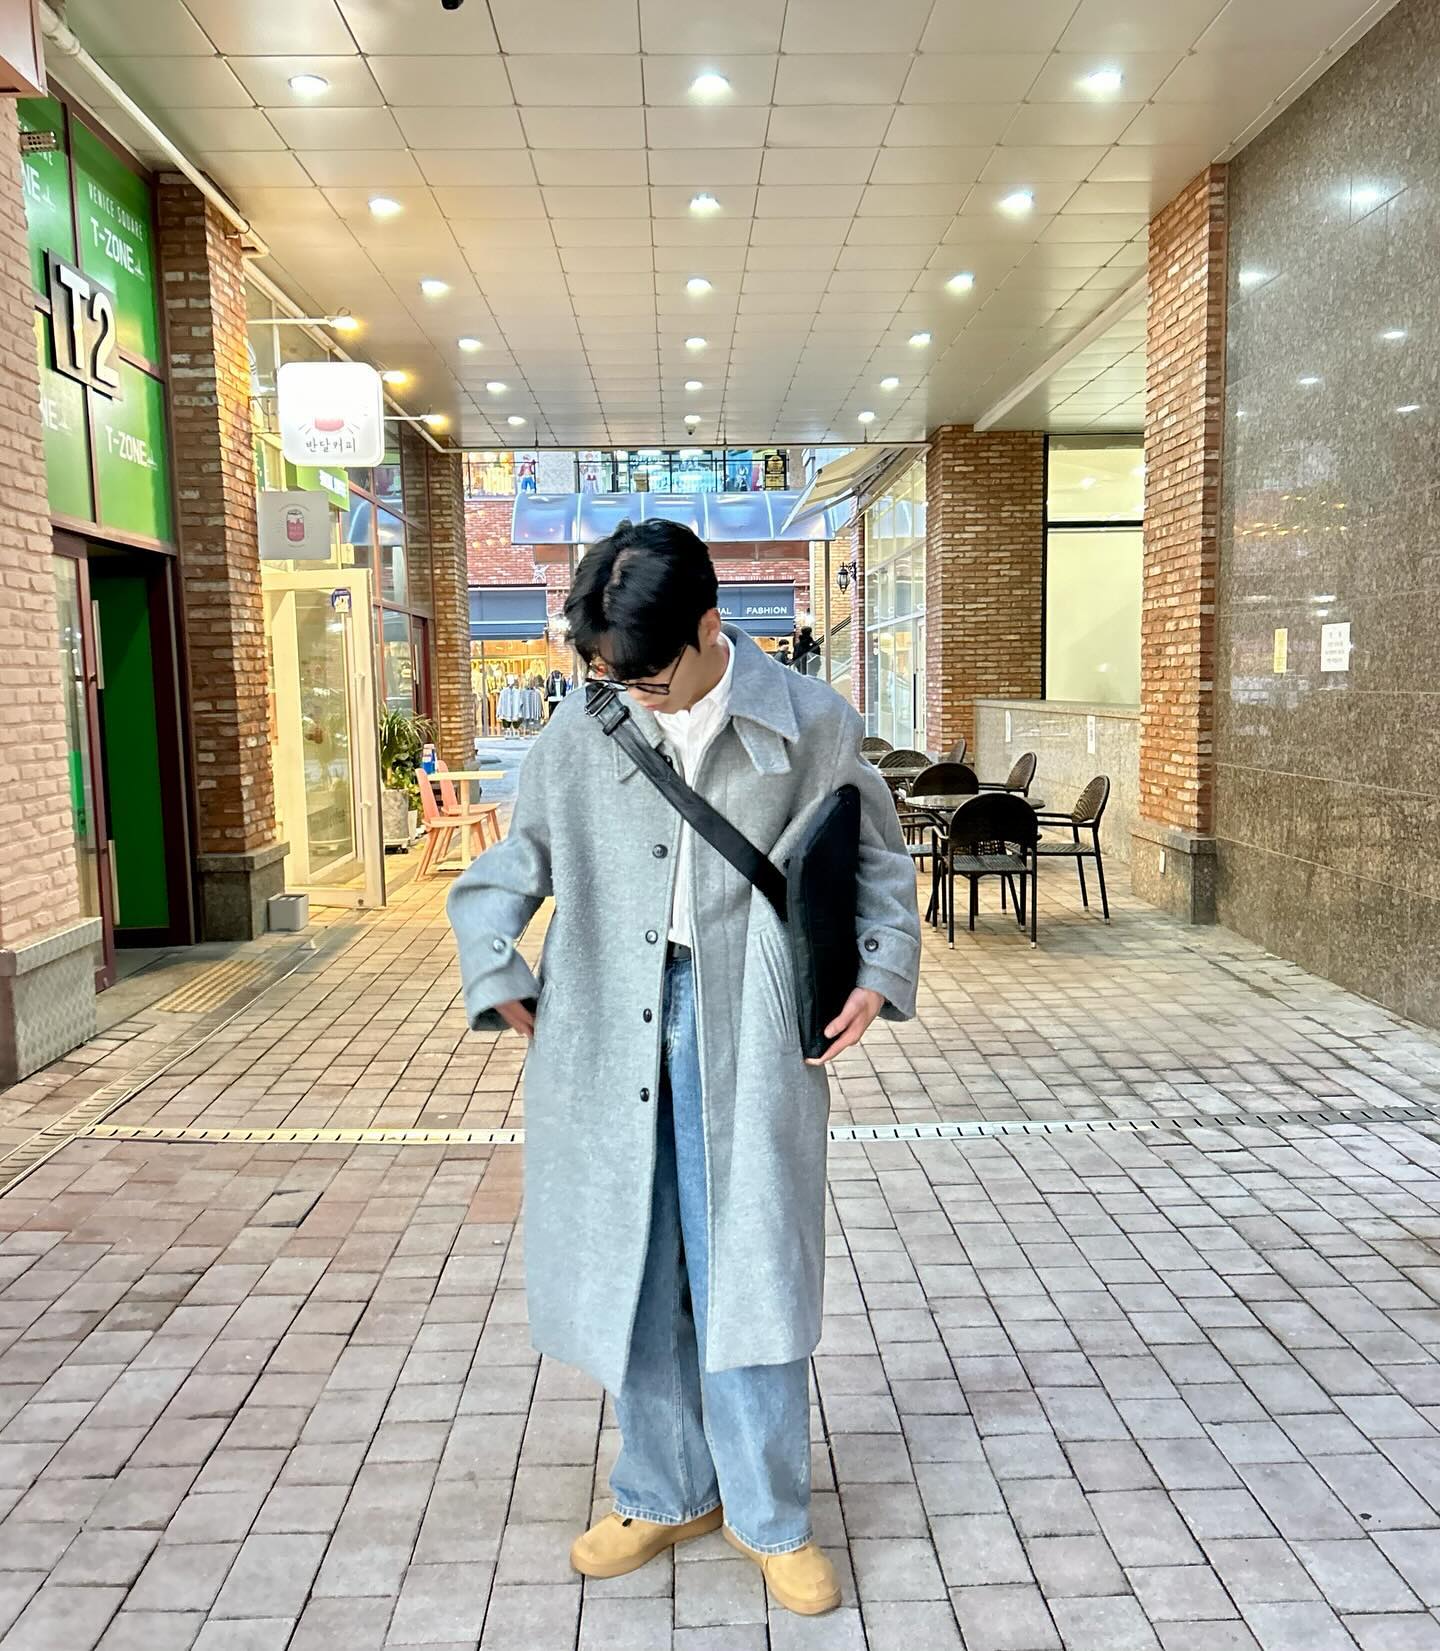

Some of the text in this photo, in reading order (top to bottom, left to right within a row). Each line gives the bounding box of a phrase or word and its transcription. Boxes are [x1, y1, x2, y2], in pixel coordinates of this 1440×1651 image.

[87, 181, 144, 242] VENICE SQUARE
[90, 215, 135, 275] T-ZONE
[57, 263, 120, 388] T2
[105, 424, 148, 468] T-ZONE
[305, 436, 356, 453] 반달커피
[746, 606, 788, 615] FASHION
